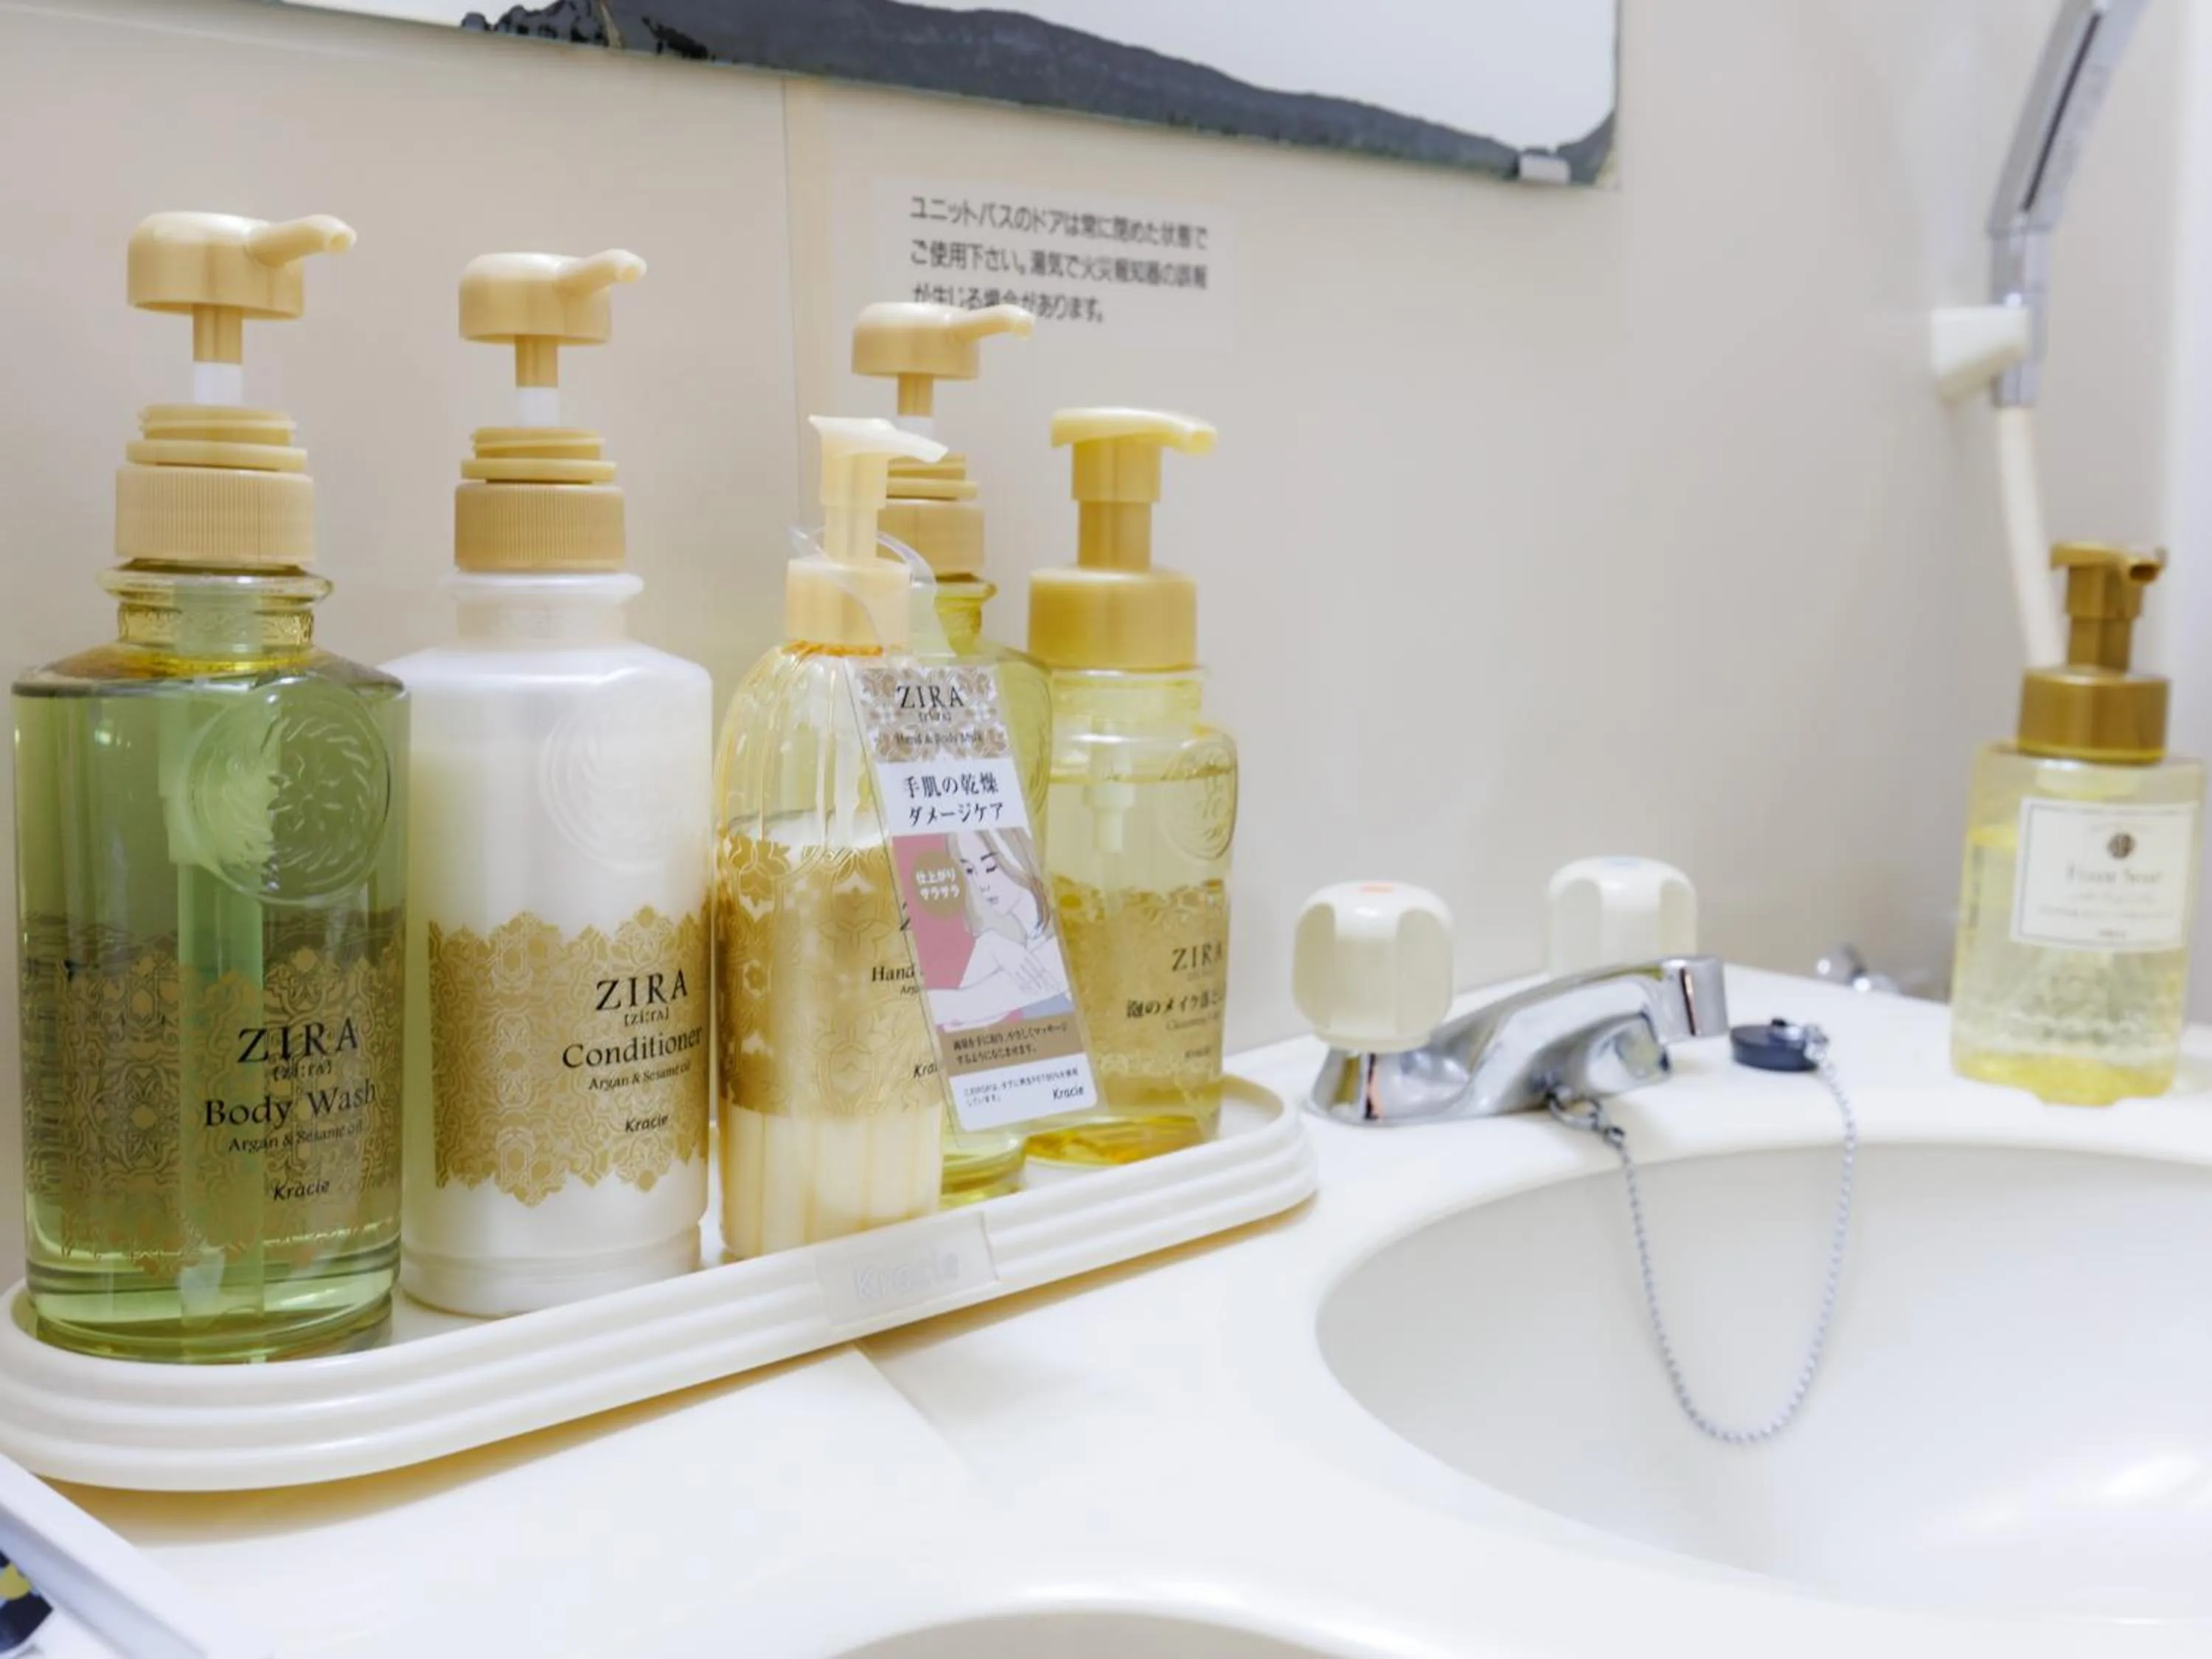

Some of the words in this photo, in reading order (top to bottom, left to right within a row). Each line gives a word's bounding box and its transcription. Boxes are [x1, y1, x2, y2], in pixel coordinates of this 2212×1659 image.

[897, 686, 964, 709] ZIRA
[904, 772, 999, 799] 手肌の乾燥
[908, 801, 1004, 827] ダメージケア
[1171, 940, 1222, 973] ZIRA
[594, 967, 688, 1011] ZIRA
[237, 1017, 358, 1063] ZIRA
[562, 1026, 703, 1069] Conditioner
[913, 1062, 939, 1079] Kra
[588, 1075, 629, 1091] Argan
[1052, 1085, 1085, 1100] Kracie
[204, 1096, 293, 1130] Body
[307, 1079, 376, 1118] Wash
[625, 1114, 669, 1133] Kracie
[229, 1137, 279, 1153] Argan
[273, 1180, 330, 1202] Kracie
